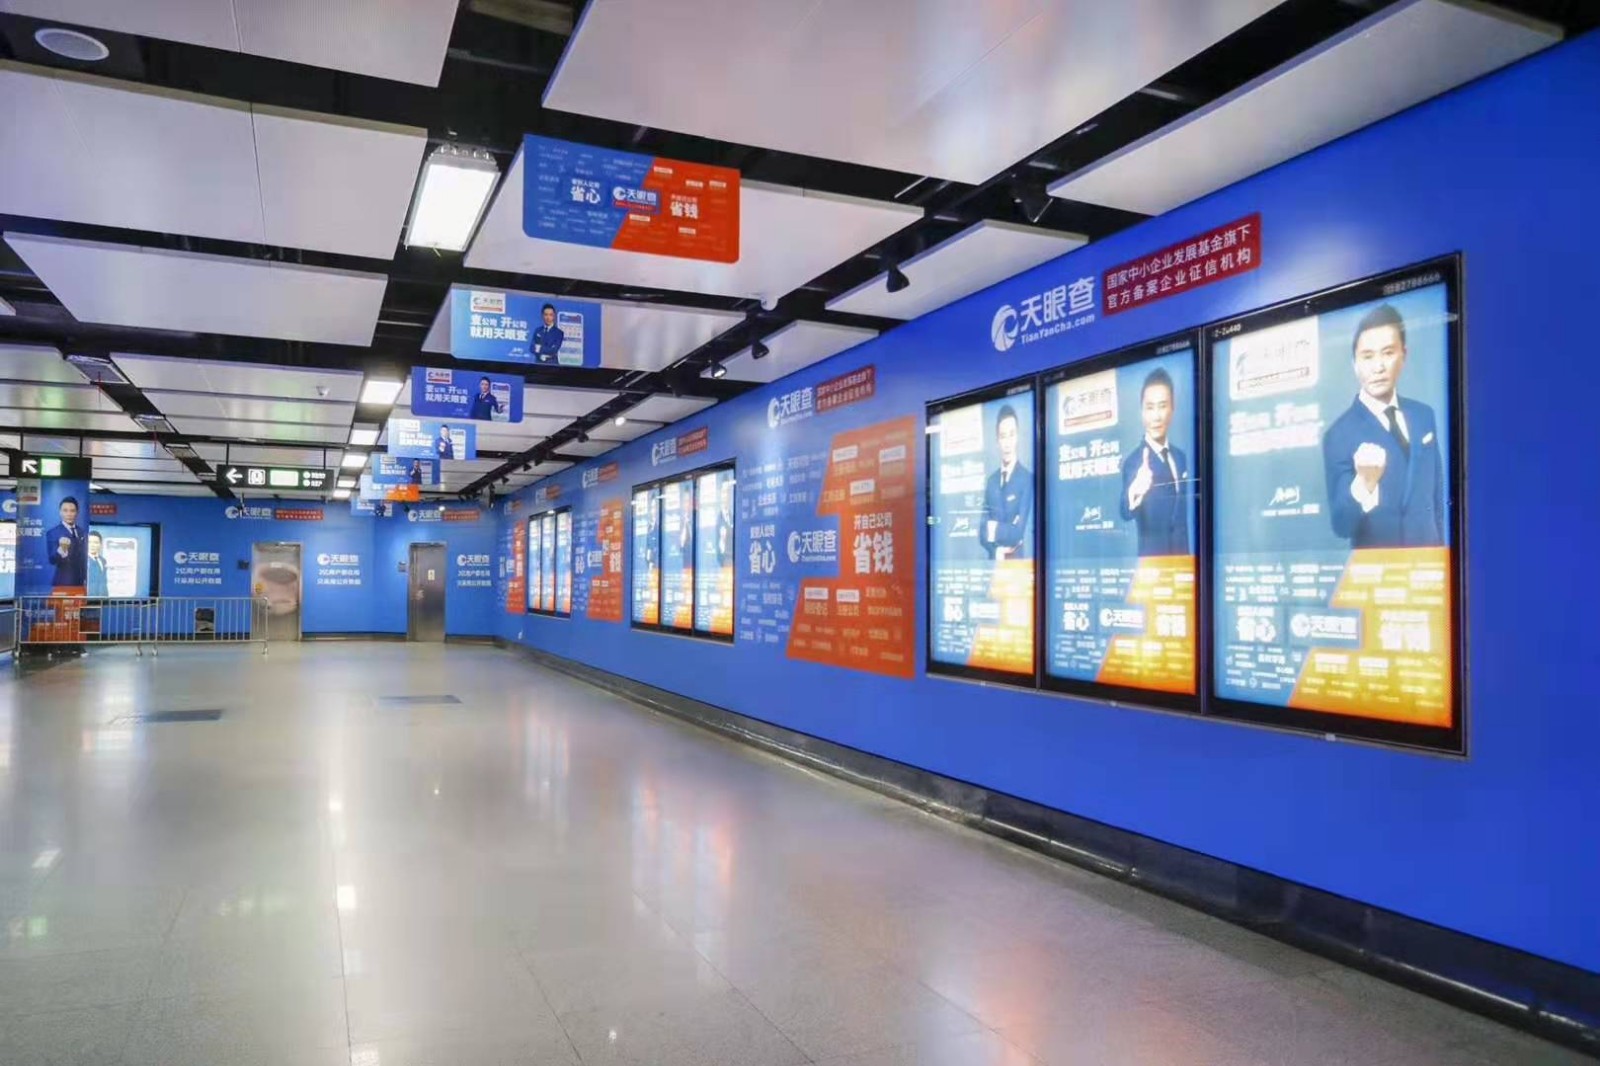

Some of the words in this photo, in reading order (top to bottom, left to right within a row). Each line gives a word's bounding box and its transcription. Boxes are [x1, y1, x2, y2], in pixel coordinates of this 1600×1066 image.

[570, 185, 601, 204] 省心
[669, 201, 699, 220] 省钱
[1106, 223, 1251, 290] 国家中小企业发展基金旗下
[1106, 247, 1251, 309] 官方备案企业征信机构
[1020, 276, 1095, 332] 天眼查
[470, 326, 529, 342] 就用天眼查
[1020, 314, 1095, 345] TianYanCha.com
[780, 387, 813, 417] 天眼查
[854, 512, 893, 530] 开自己公司
[801, 530, 837, 553] 天眼查
[853, 530, 894, 574] 省钱
[749, 540, 776, 575] 省心
